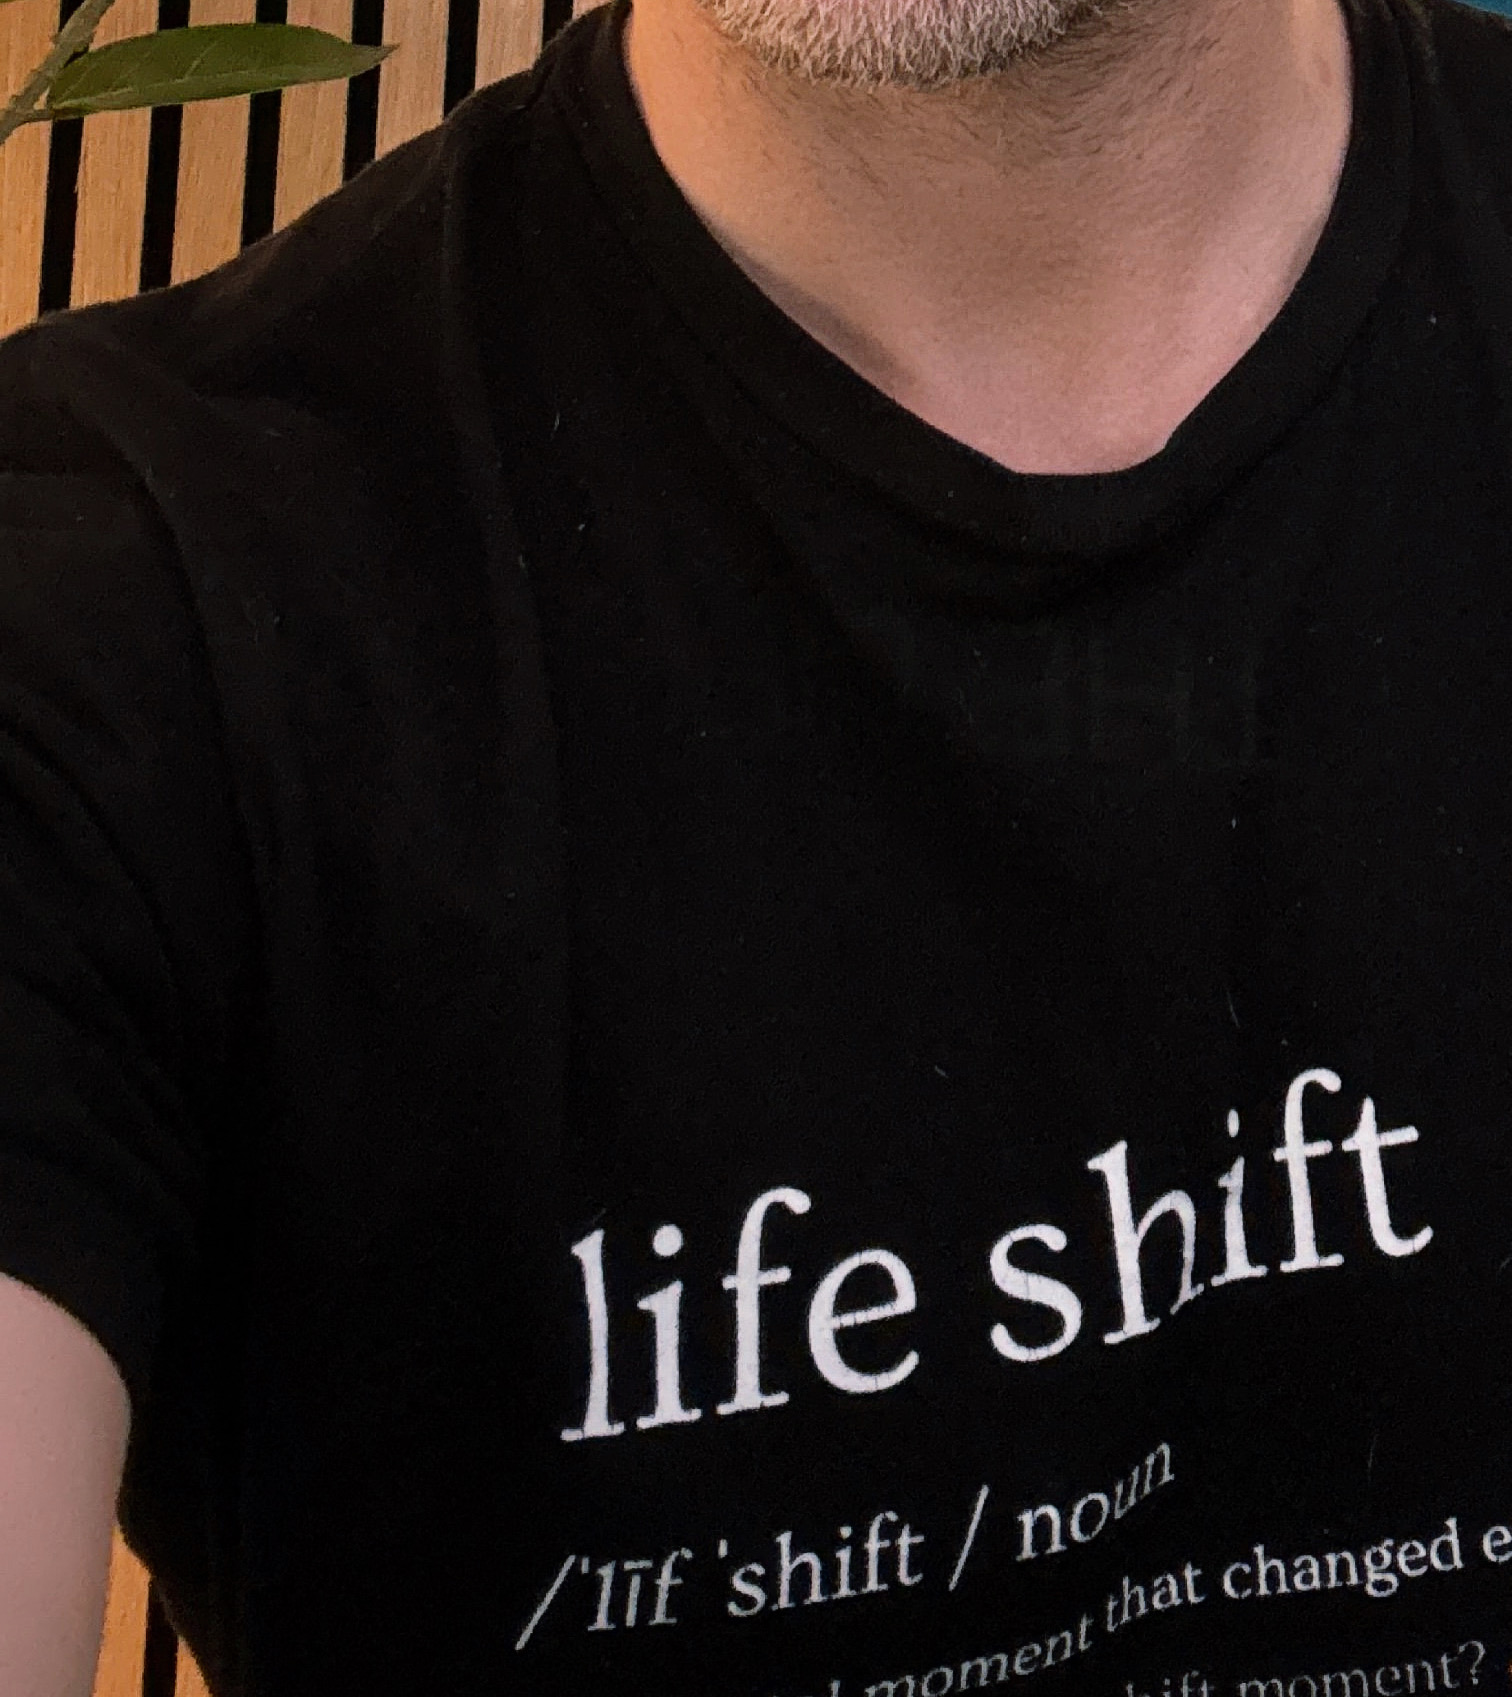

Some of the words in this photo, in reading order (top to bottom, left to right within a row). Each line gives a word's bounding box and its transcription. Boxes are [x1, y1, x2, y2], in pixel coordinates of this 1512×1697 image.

[560, 1186, 920, 1442] life
[989, 1067, 1434, 1364] shift
[1016, 1442, 1175, 1562] noun
[1107, 1561, 1206, 1632] that
[1222, 1517, 1464, 1599] changed
